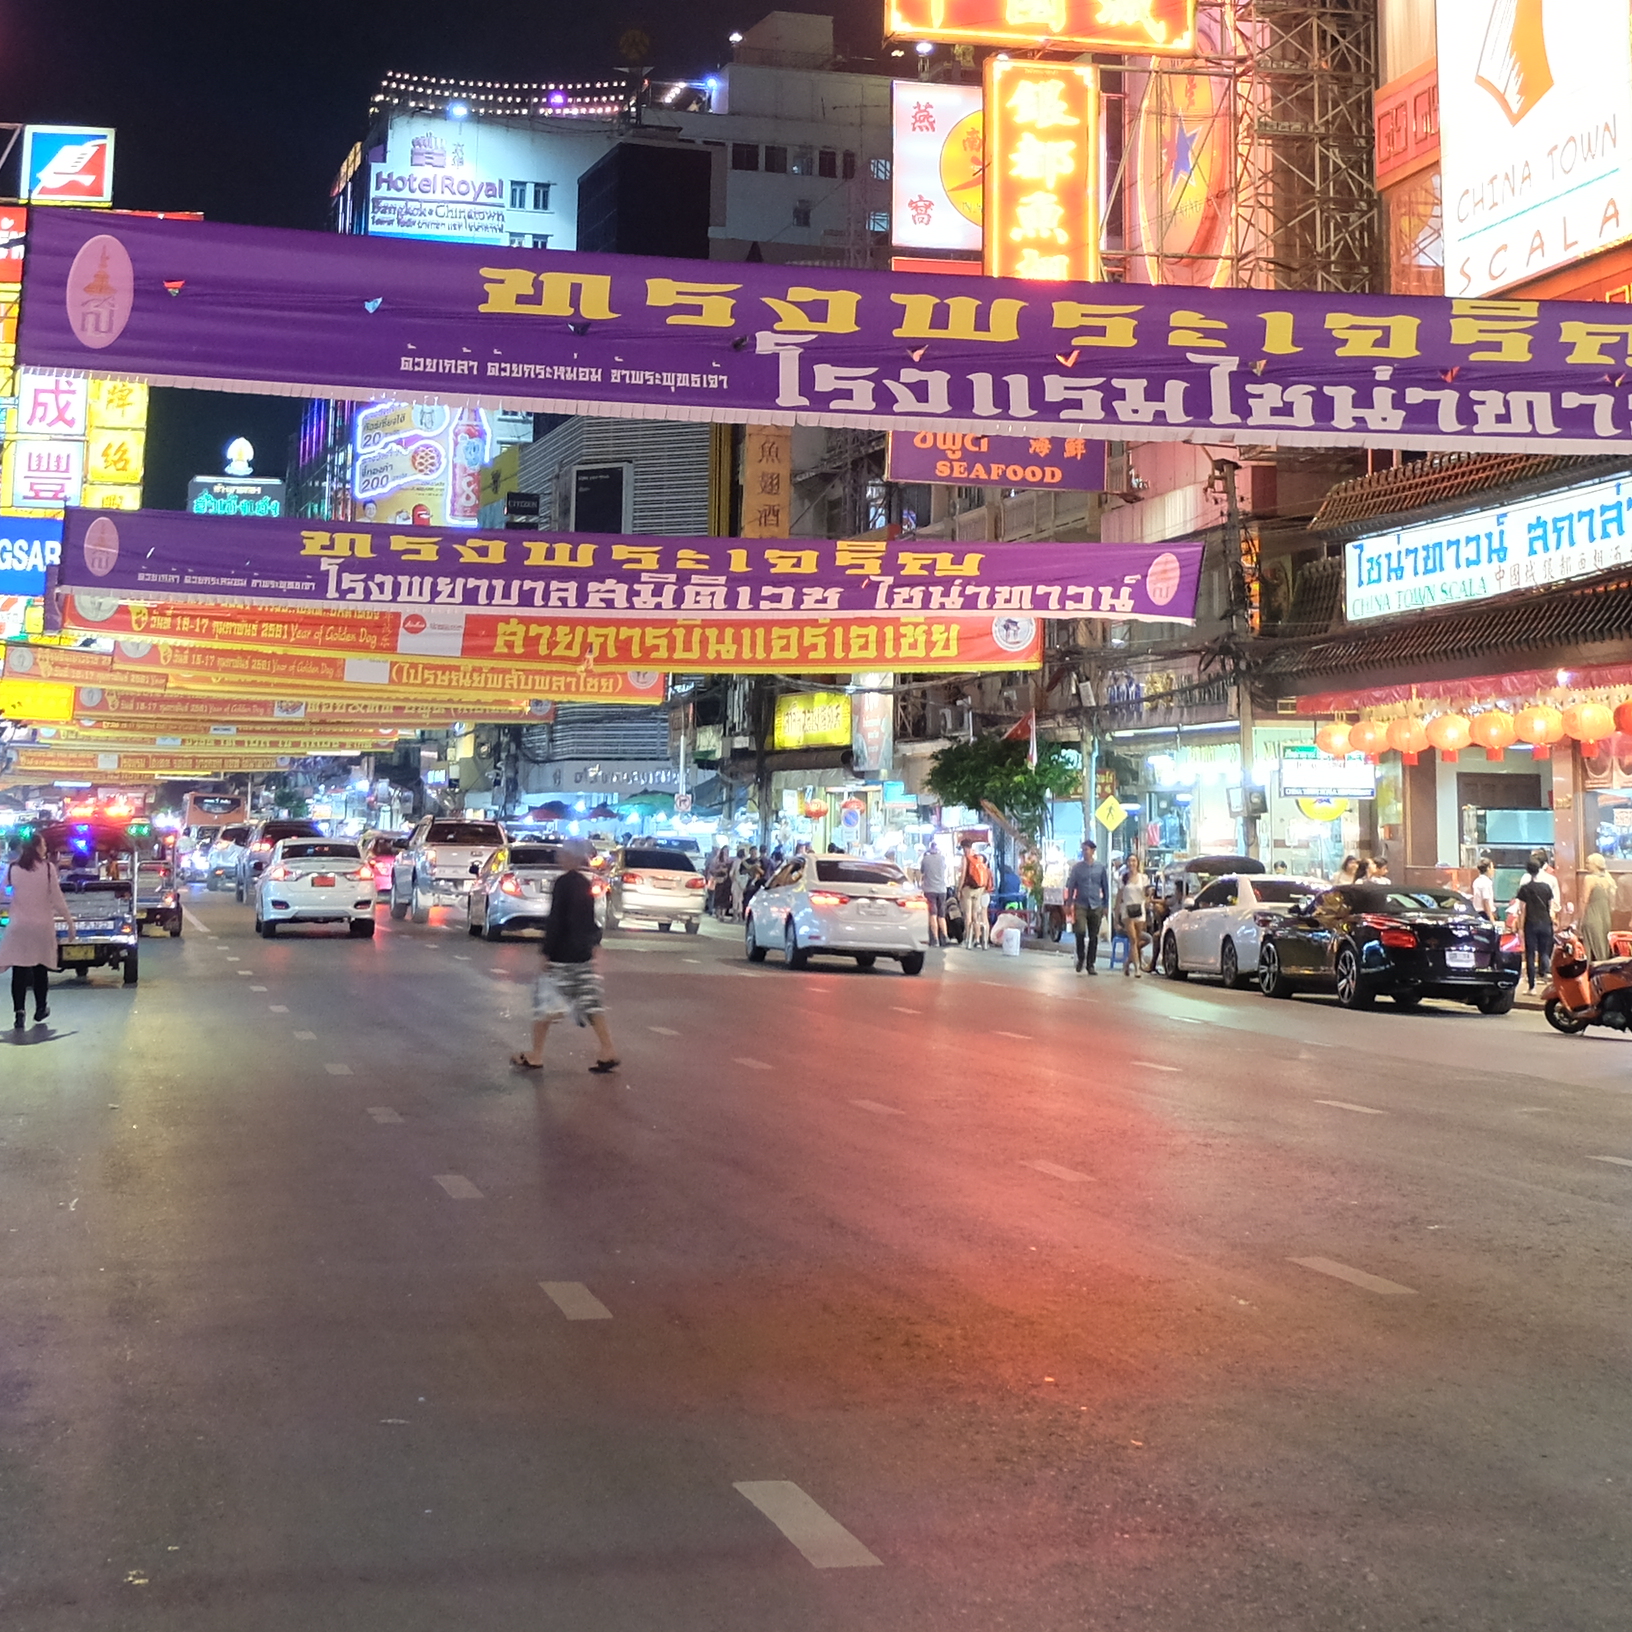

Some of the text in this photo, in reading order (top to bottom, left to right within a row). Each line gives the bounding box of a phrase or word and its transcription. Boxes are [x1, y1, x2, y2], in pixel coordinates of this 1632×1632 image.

[1455, 111, 1618, 226] CHINA TOWN
[1458, 196, 1622, 297] SCALA
[361, 474, 391, 493] 200
[757, 426, 782, 537] 魚翅酒
[934, 460, 1063, 484] SEAFOOD
[299, 529, 985, 577] ทรงพระเจริญ
[1351, 512, 1509, 588] ไชน่าทาวน์
[1439, 576, 1489, 600] SCALA
[325, 625, 357, 644] Golden
[359, 627, 378, 647] Dog
